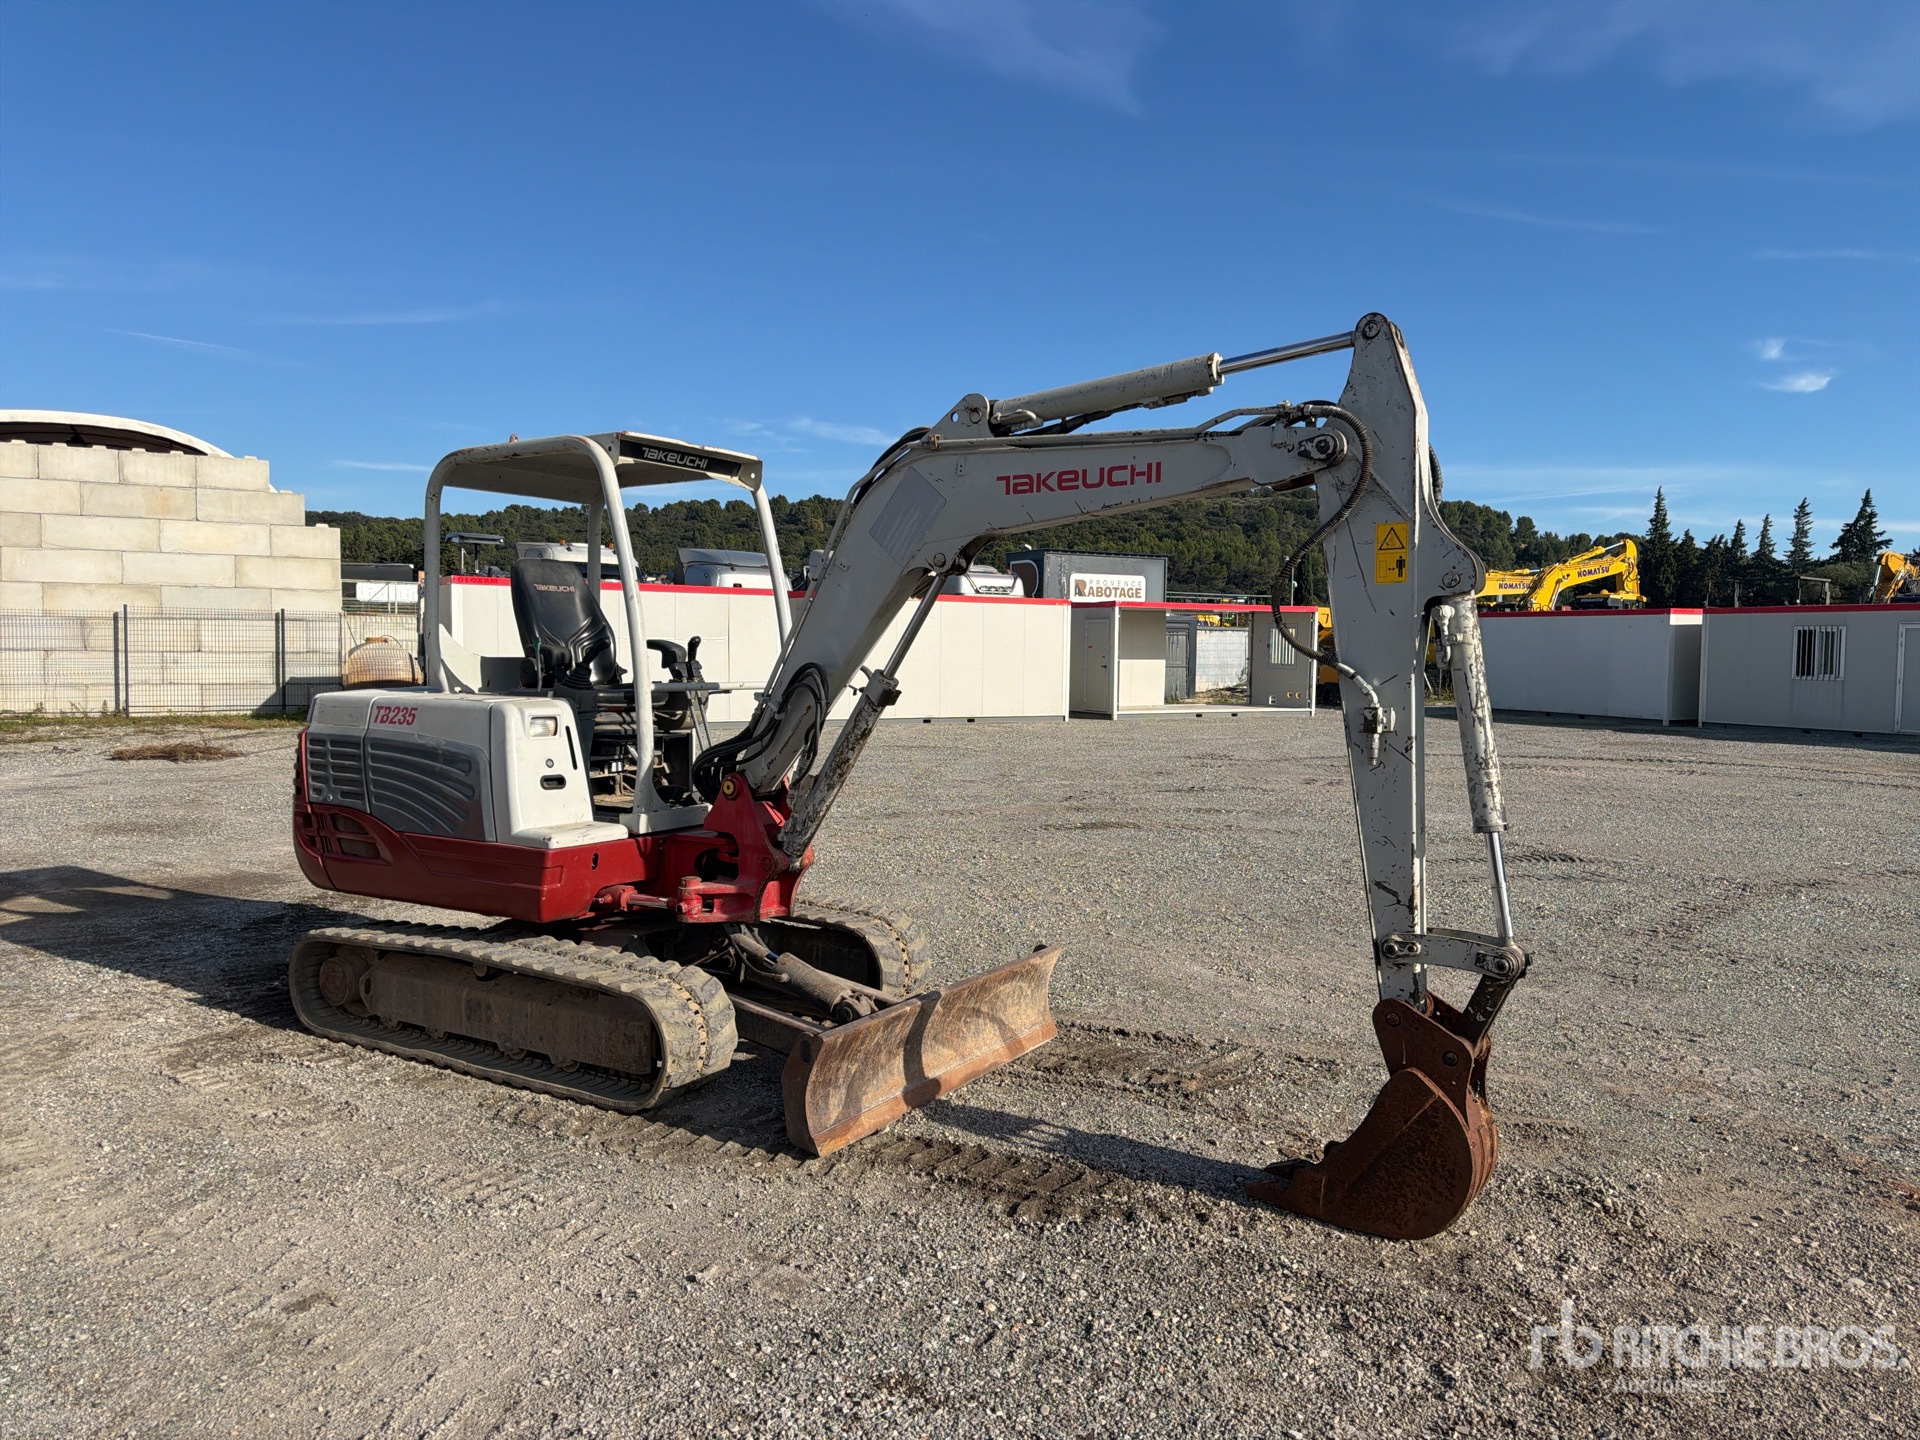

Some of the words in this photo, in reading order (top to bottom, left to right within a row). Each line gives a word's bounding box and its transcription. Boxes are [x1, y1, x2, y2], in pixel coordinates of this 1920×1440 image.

[1577, 565, 1610, 578] KOMATSU
[1088, 579, 1143, 588] PROVENCE
[373, 706, 418, 726] TB235
